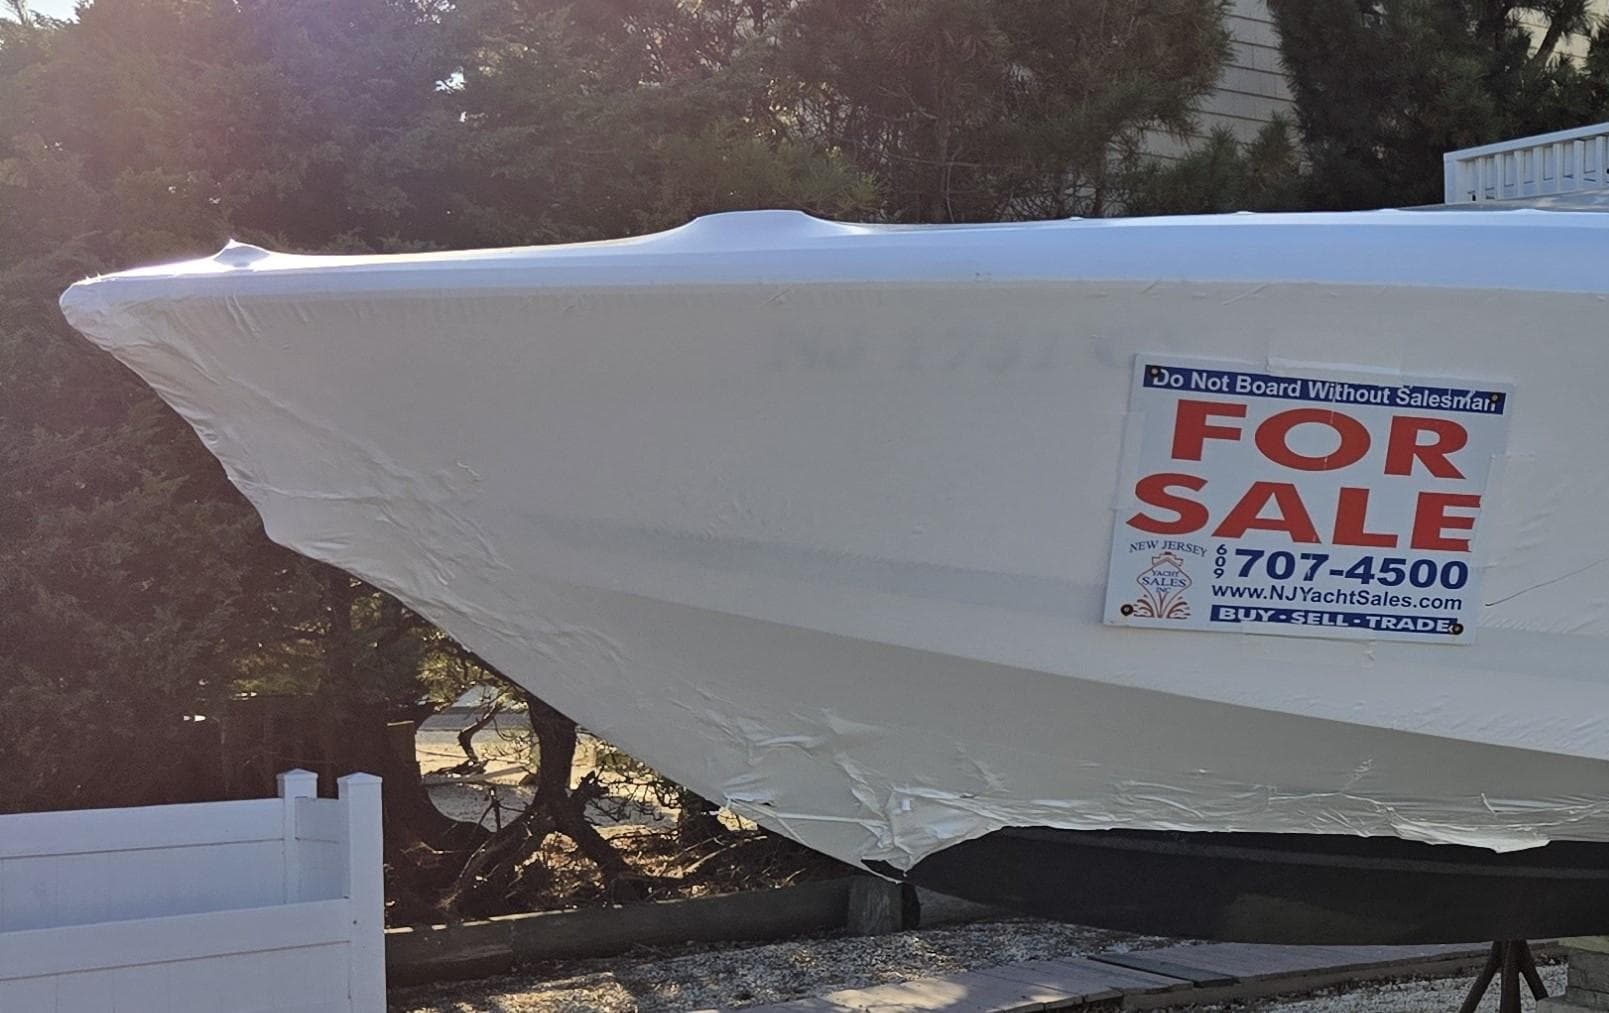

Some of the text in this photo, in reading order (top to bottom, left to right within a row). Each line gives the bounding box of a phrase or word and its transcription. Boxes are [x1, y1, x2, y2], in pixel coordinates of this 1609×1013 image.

[1152, 368, 1496, 412] Do Not Board Without Salesman
[1171, 398, 1469, 480] FOR
[1126, 472, 1482, 552] SALE
[1128, 540, 1208, 557] NEW JERSEY
[1142, 576, 1187, 588] SALES
[1151, 569, 1180, 578] YACHT
[1235, 548, 1469, 590] 707-4500
[1211, 583, 1463, 611] www.NJYachtSales.com
[1218, 606, 1452, 633] BUY SELL TRADE
